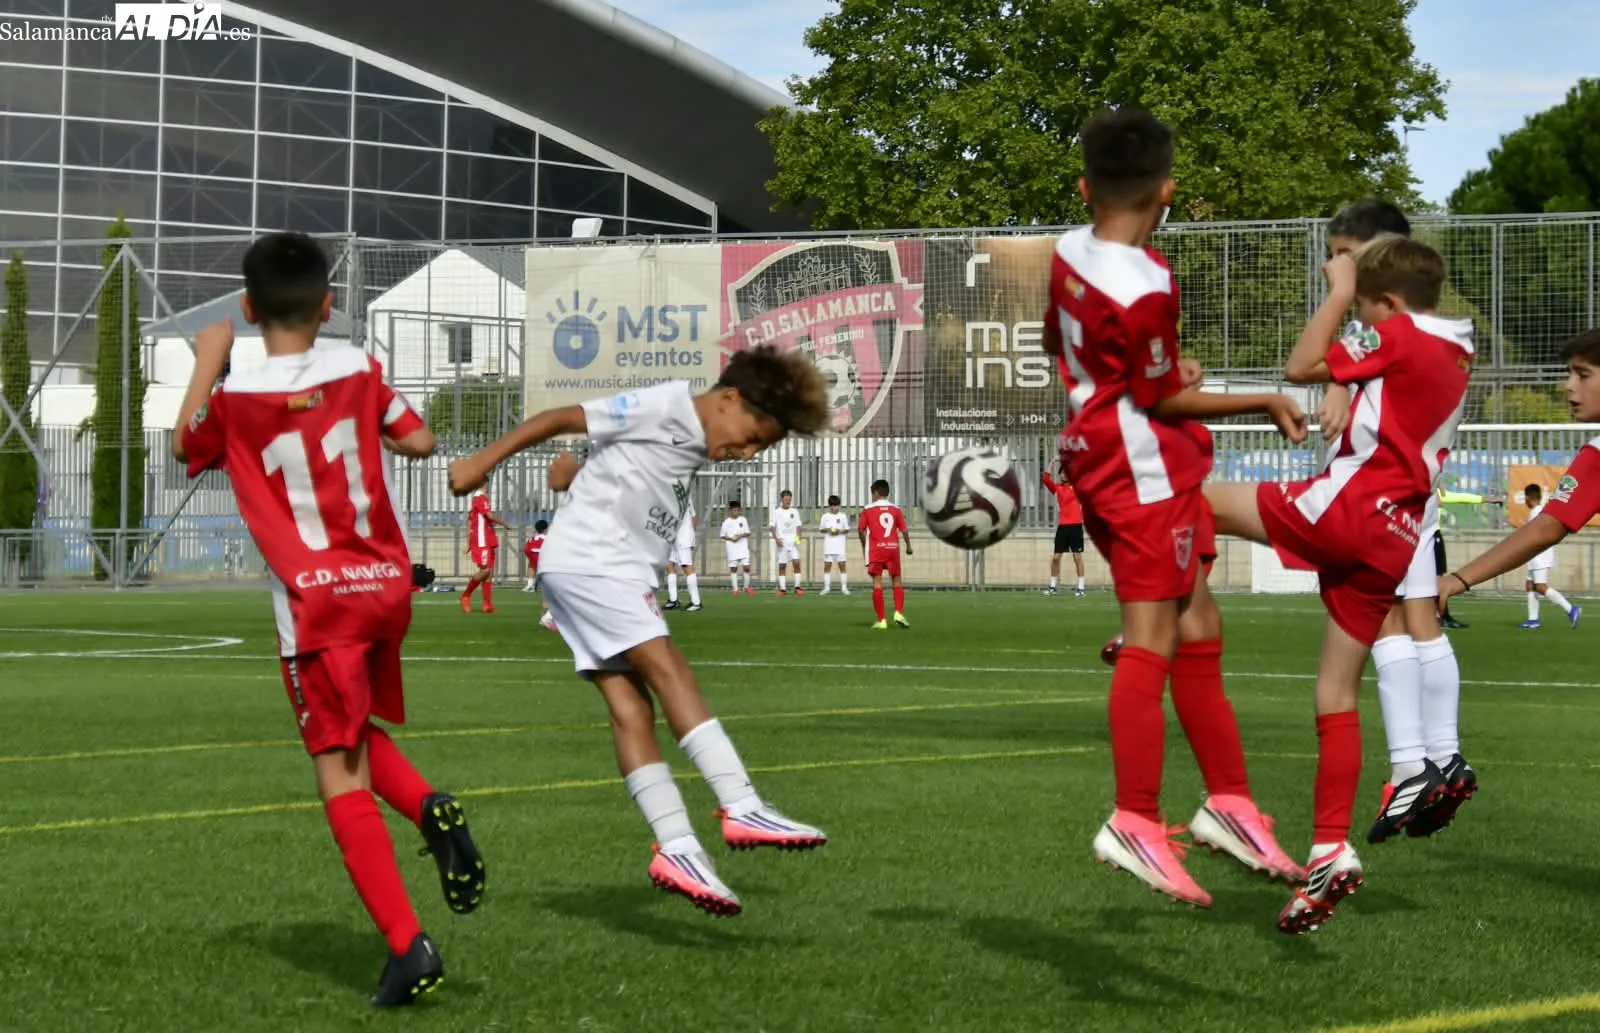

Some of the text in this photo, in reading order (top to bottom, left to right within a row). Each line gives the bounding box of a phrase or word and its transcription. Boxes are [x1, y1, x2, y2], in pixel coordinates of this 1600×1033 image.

[616, 304, 707, 344] MST
[615, 348, 703, 368] eventos
[936, 408, 997, 418] Instalaciones
[941, 421, 995, 431] Industriales
[261, 416, 372, 551] 11
[879, 512, 894, 538] 9
[295, 569, 339, 589] C.D.
